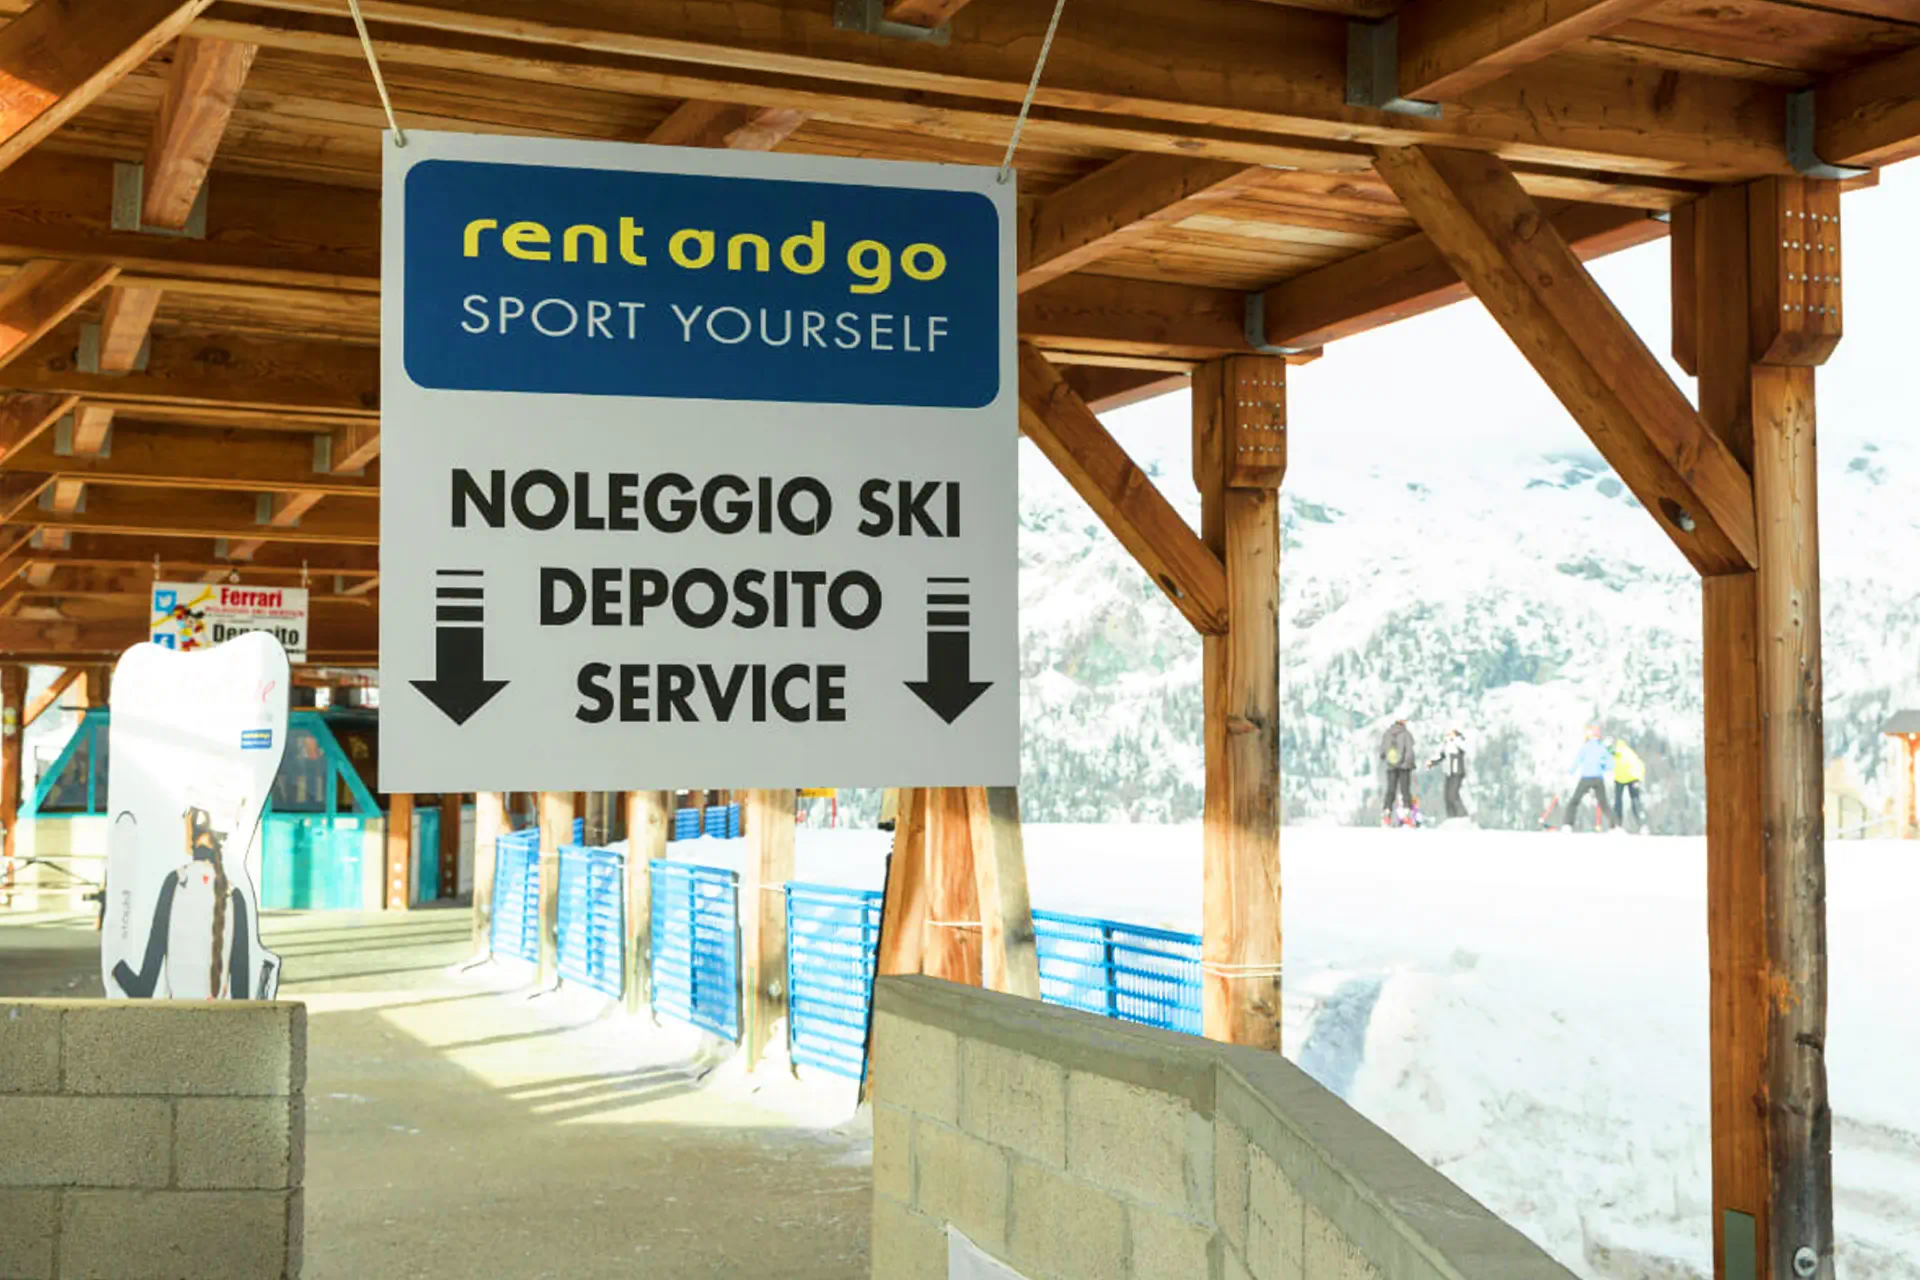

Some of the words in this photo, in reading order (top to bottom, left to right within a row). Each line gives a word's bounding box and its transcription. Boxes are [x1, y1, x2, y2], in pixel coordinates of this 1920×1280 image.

[463, 216, 647, 266] rent
[668, 220, 825, 275] and
[847, 239, 946, 294] go
[461, 294, 645, 339] SPORT
[671, 304, 949, 352] YOURSELF
[451, 468, 833, 536] NOLEGGIO
[857, 478, 961, 538] SKI
[220, 587, 282, 608] Ferrari
[540, 567, 882, 631] DEPOSITO
[213, 623, 299, 645] Deito
[575, 662, 846, 724] SERVICE
